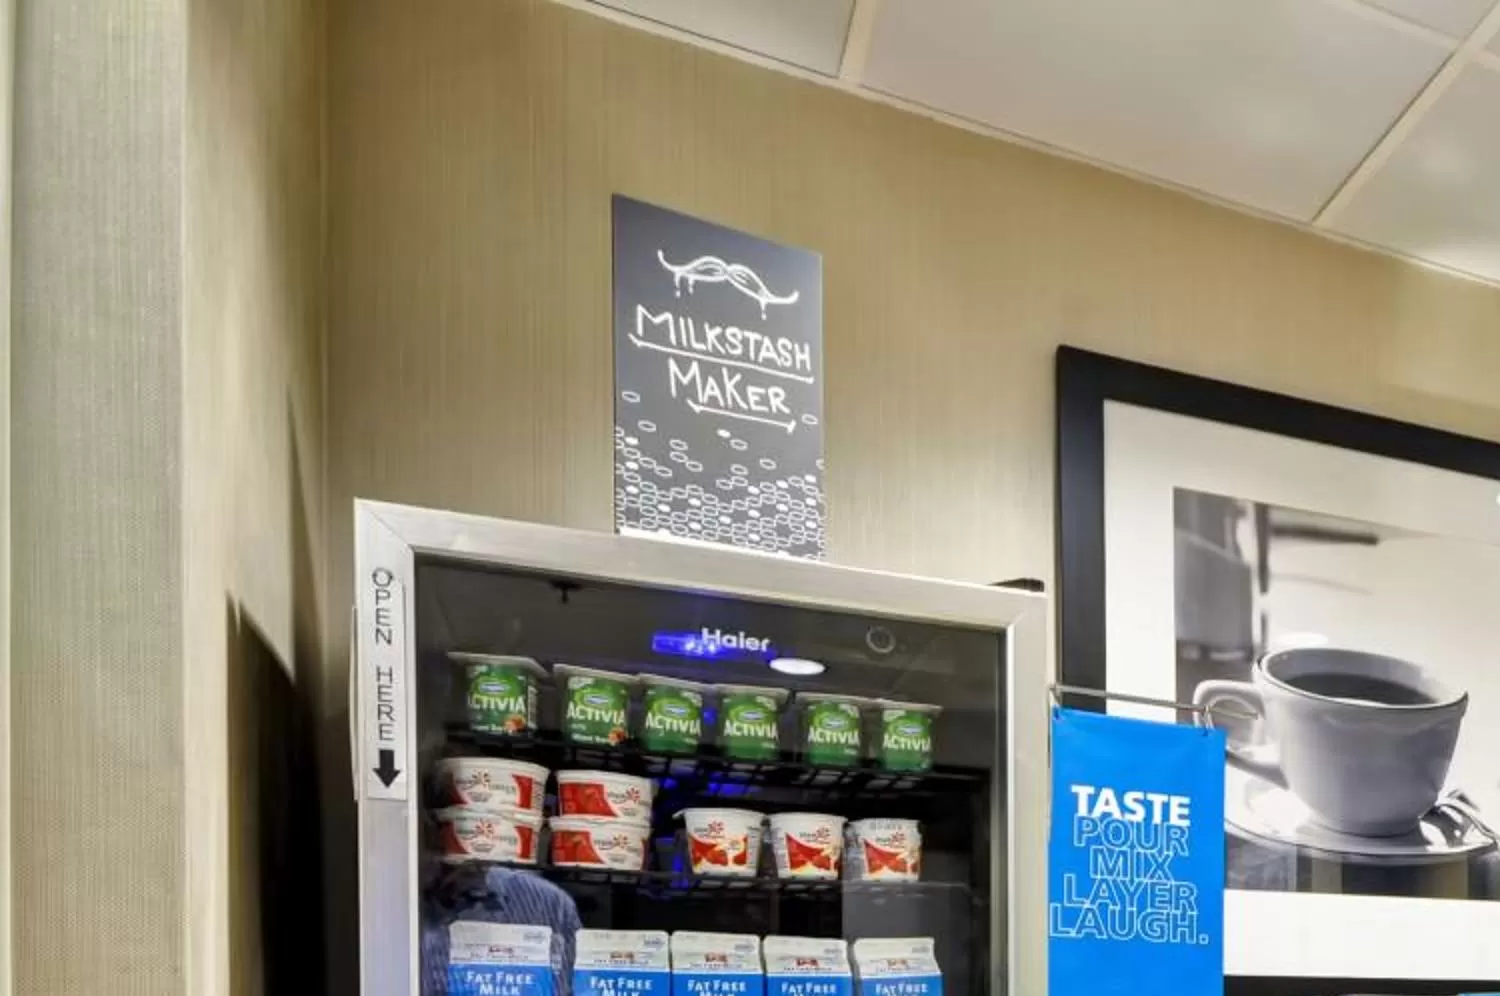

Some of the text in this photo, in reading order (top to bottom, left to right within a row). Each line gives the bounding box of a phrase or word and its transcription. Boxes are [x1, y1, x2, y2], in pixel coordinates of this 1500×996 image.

[636, 304, 812, 371] MILKSTASH
[668, 357, 790, 414] MAKER
[371, 566, 395, 742] OPEN HERE
[701, 627, 772, 652] Haier
[567, 701, 627, 727] ACTIVIA
[723, 719, 779, 740] ACTIVIA
[808, 727, 861, 746] ACTIVIA
[1071, 784, 1192, 827] TASTE
[1074, 815, 1189, 856] POUR
[1089, 845, 1175, 884] MIX
[1064, 873, 1200, 914] LAYER
[1050, 903, 1210, 945] LAUGH.
[589, 976, 654, 991] FAT FREE
[687, 979, 747, 994] FAT FREE
